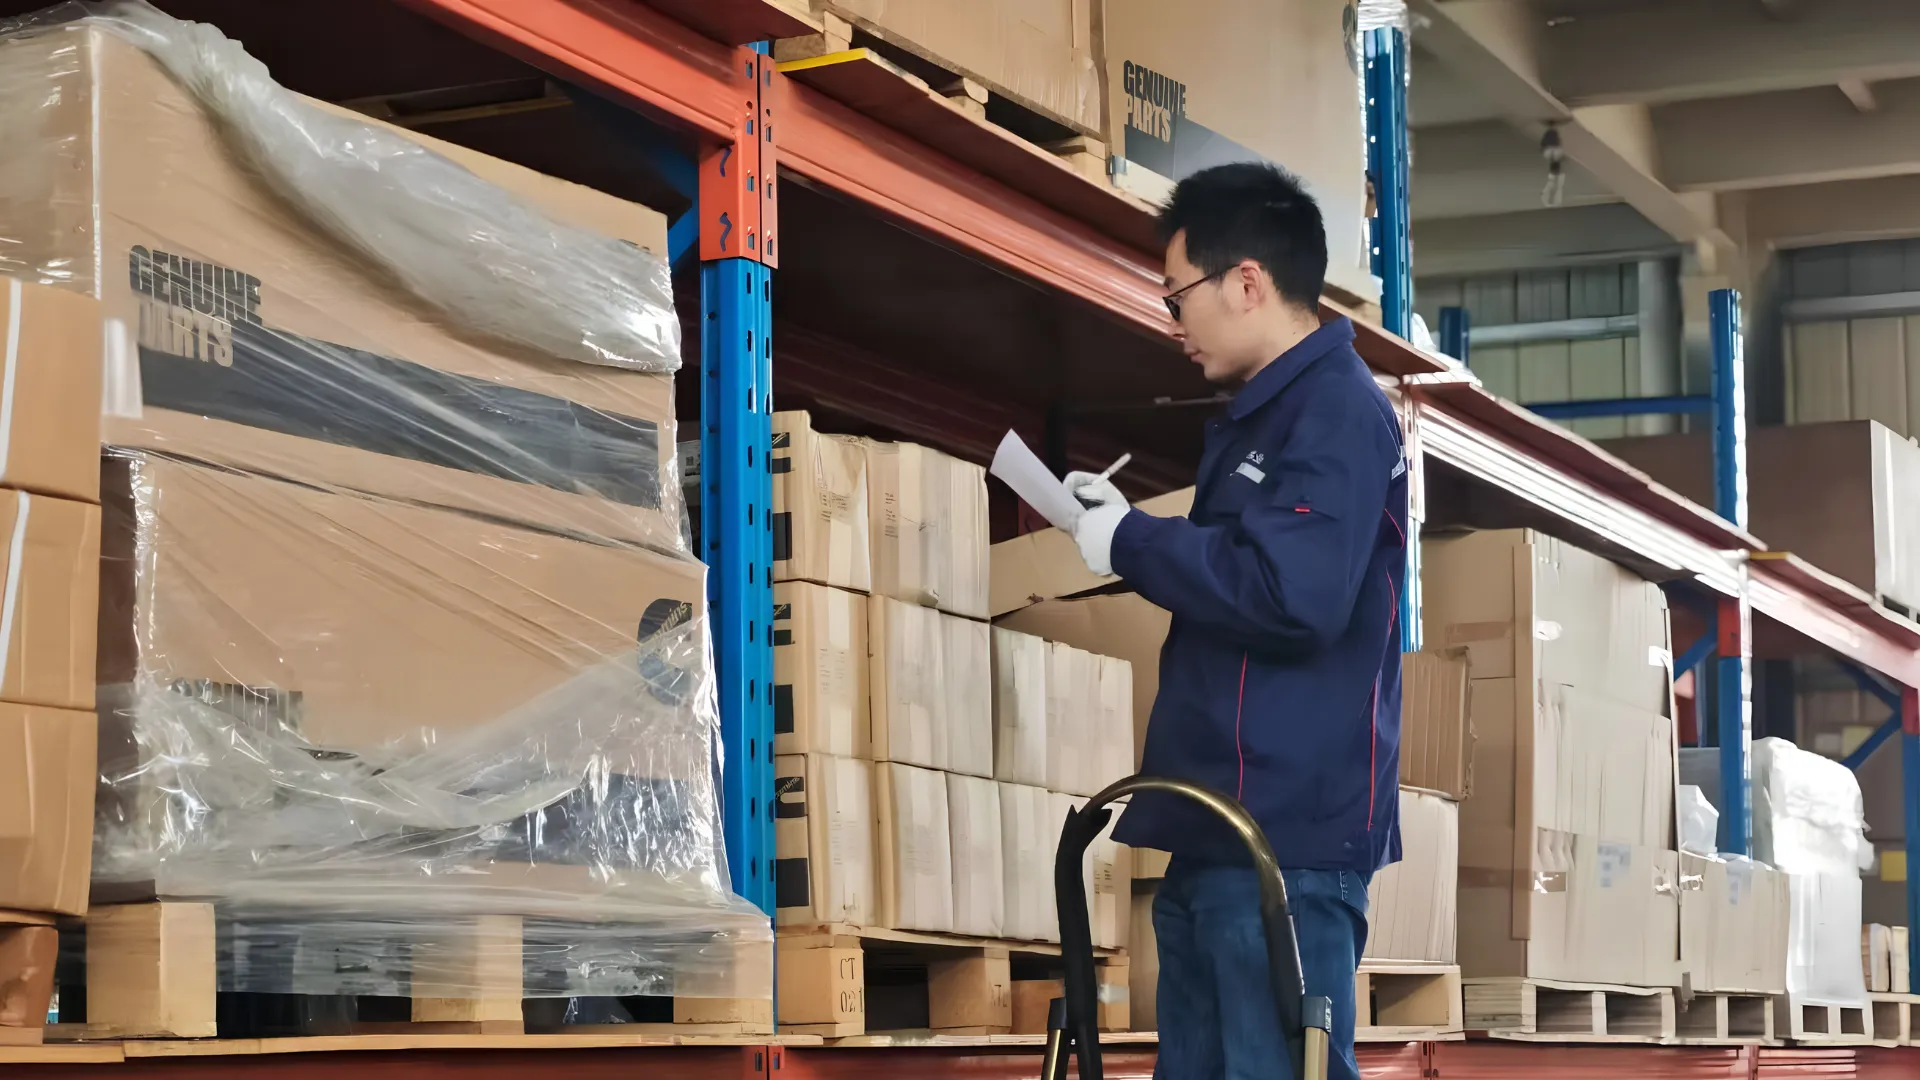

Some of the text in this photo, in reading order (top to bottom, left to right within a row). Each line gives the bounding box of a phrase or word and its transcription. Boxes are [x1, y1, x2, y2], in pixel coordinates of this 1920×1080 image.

[1123, 59, 1186, 118] GENUINE
[1124, 93, 1171, 143] PARTS
[129, 244, 262, 325] GENUINE
